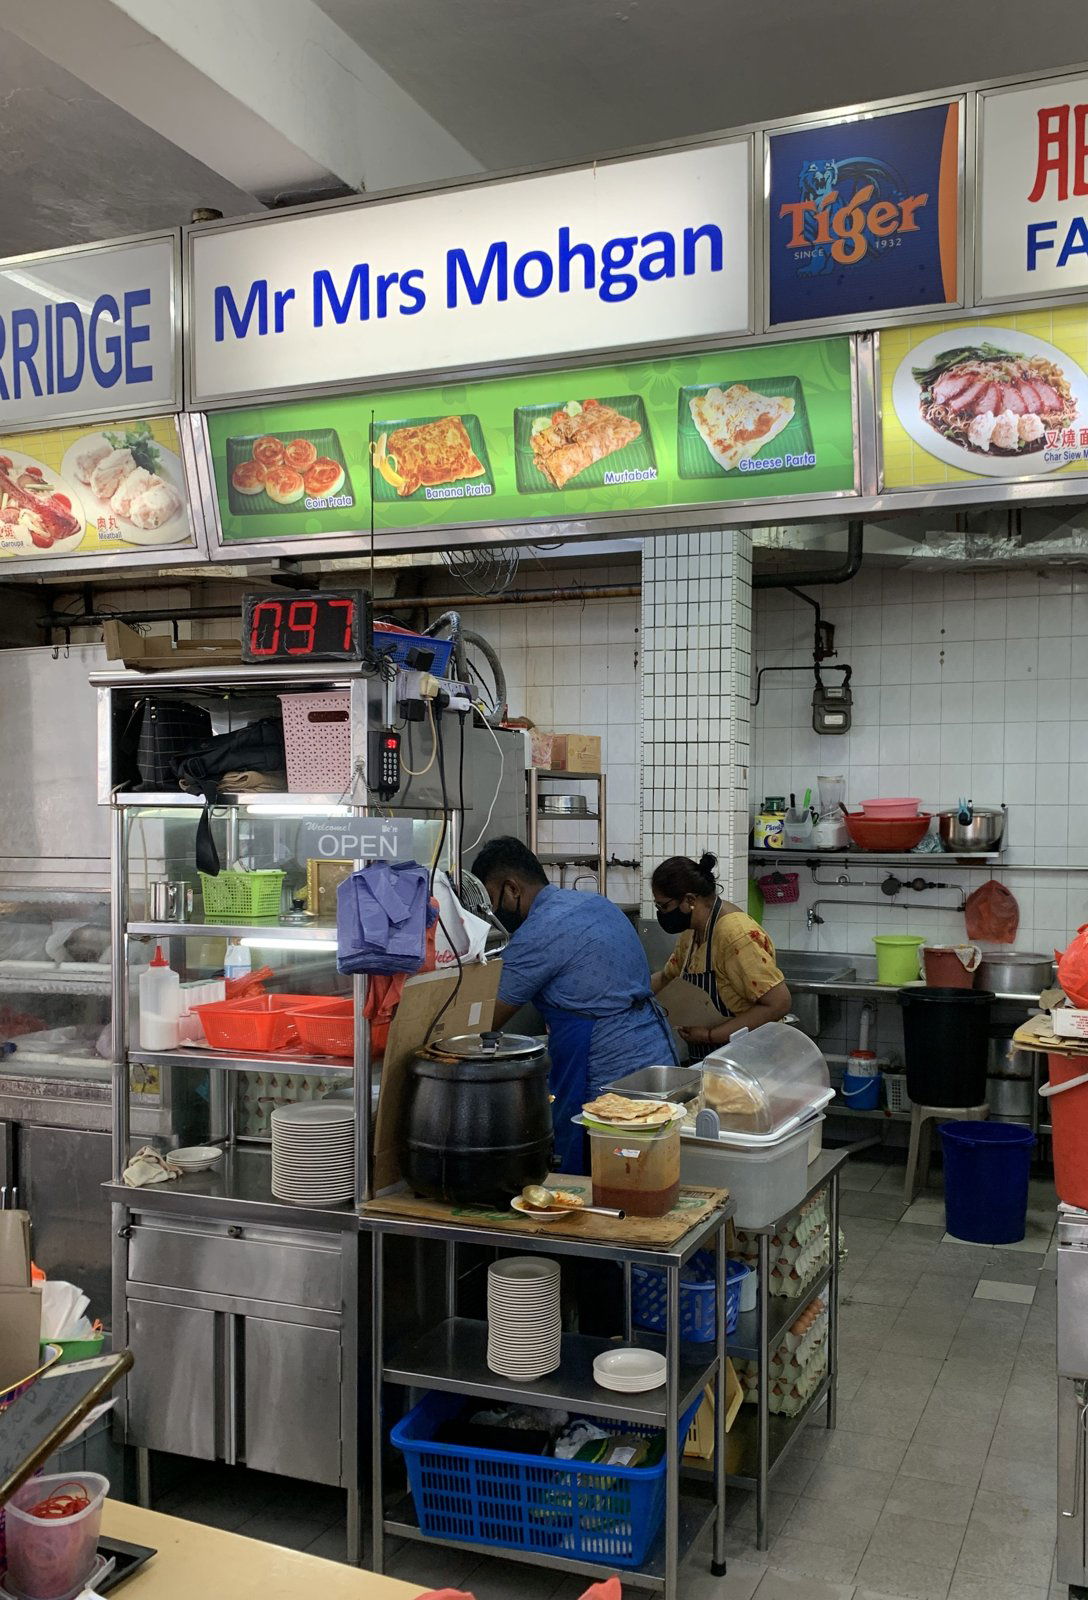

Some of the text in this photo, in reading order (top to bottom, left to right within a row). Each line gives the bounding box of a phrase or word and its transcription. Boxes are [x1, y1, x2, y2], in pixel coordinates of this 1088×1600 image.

[779, 184, 929, 264] Tiger
[794, 238, 902, 259] SINCE 1932
[213, 223, 723, 342] Mr Mrs Mohgan
[1044, 452, 1062, 462] Char
[1063, 450, 1082, 460] Siew
[740, 459, 781, 471] Cheese
[605, 470, 656, 482] Murtabak
[426, 484, 491, 499] Banana Prata
[305, 495, 352, 509] Coin Prata
[98, 531, 122, 540] Meatball
[250, 600, 353, 654] 097
[305, 821, 352, 832] Welcome!
[318, 834, 397, 857] OPEN
